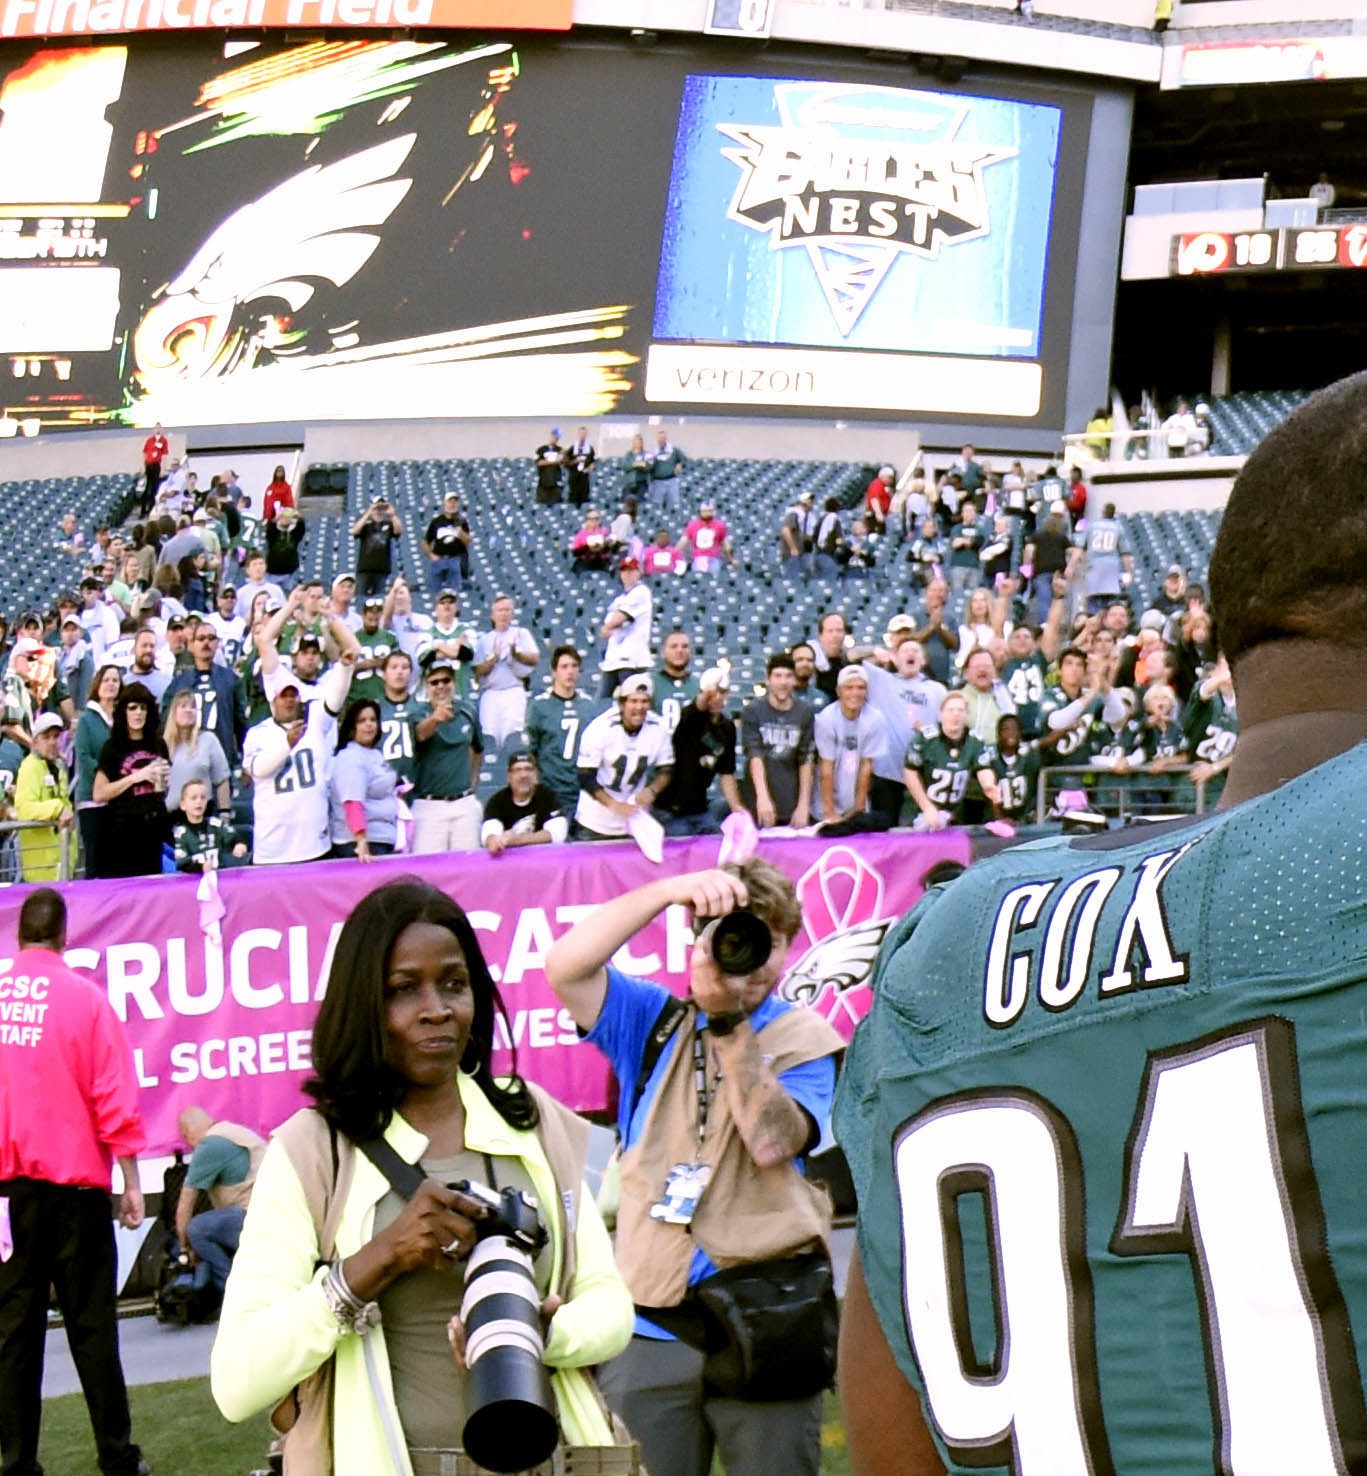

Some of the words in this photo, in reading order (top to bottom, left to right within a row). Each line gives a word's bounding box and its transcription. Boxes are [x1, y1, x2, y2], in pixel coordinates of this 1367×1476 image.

[781, 196, 938, 245] NEST
[676, 367, 816, 393] verizon
[561, 718, 579, 760] 7
[274, 748, 315, 794] 20
[927, 768, 969, 804] 29
[982, 840, 1200, 1030] COX
[0, 1001, 48, 1025] VENT
[0, 1023, 42, 1047] TAFF
